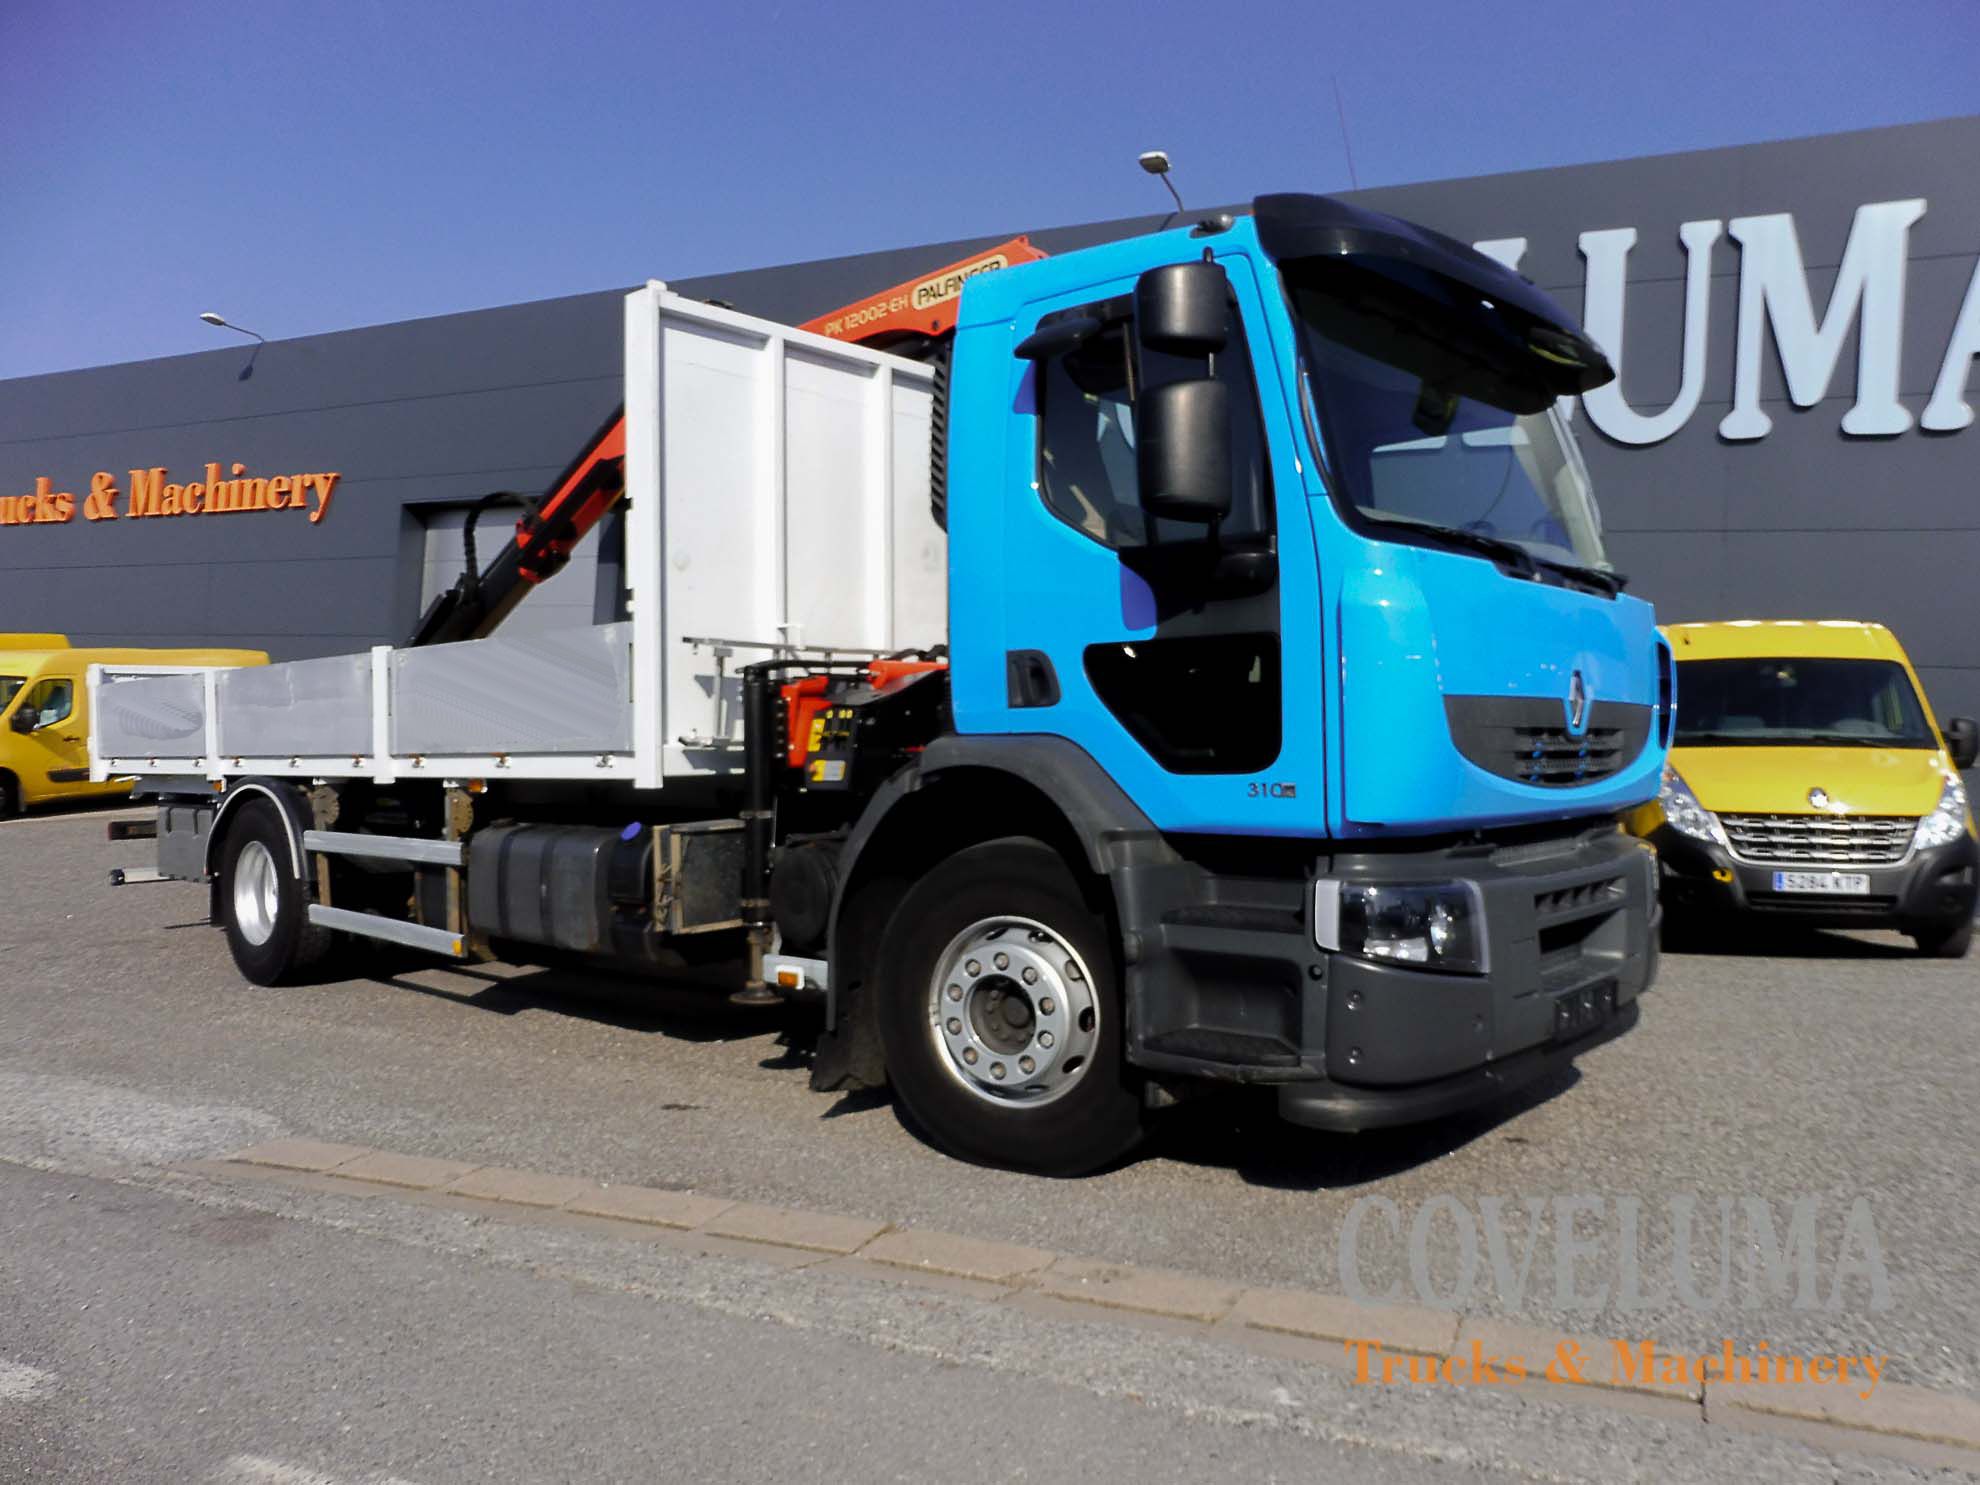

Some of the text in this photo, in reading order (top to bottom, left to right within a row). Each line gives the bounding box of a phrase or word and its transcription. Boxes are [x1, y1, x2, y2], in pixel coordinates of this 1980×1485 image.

[83, 471, 120, 521] &
[125, 462, 341, 523] Machinery
[1248, 782, 1281, 798] 310
